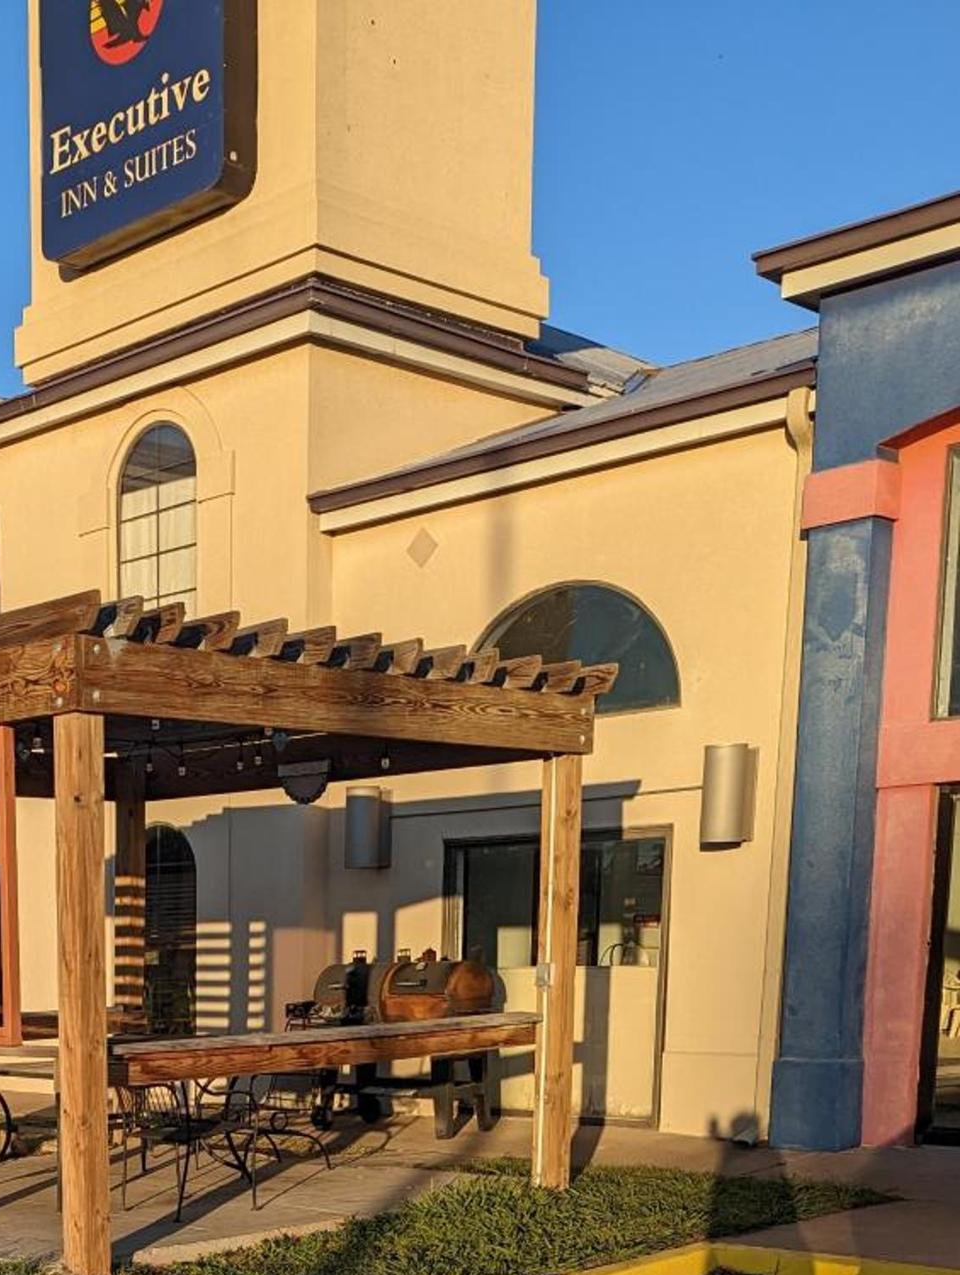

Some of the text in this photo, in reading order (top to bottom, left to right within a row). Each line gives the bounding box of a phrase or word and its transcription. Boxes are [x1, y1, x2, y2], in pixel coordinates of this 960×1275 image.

[49, 68, 211, 174] Executive
[60, 129, 197, 218] INN & SUITES
